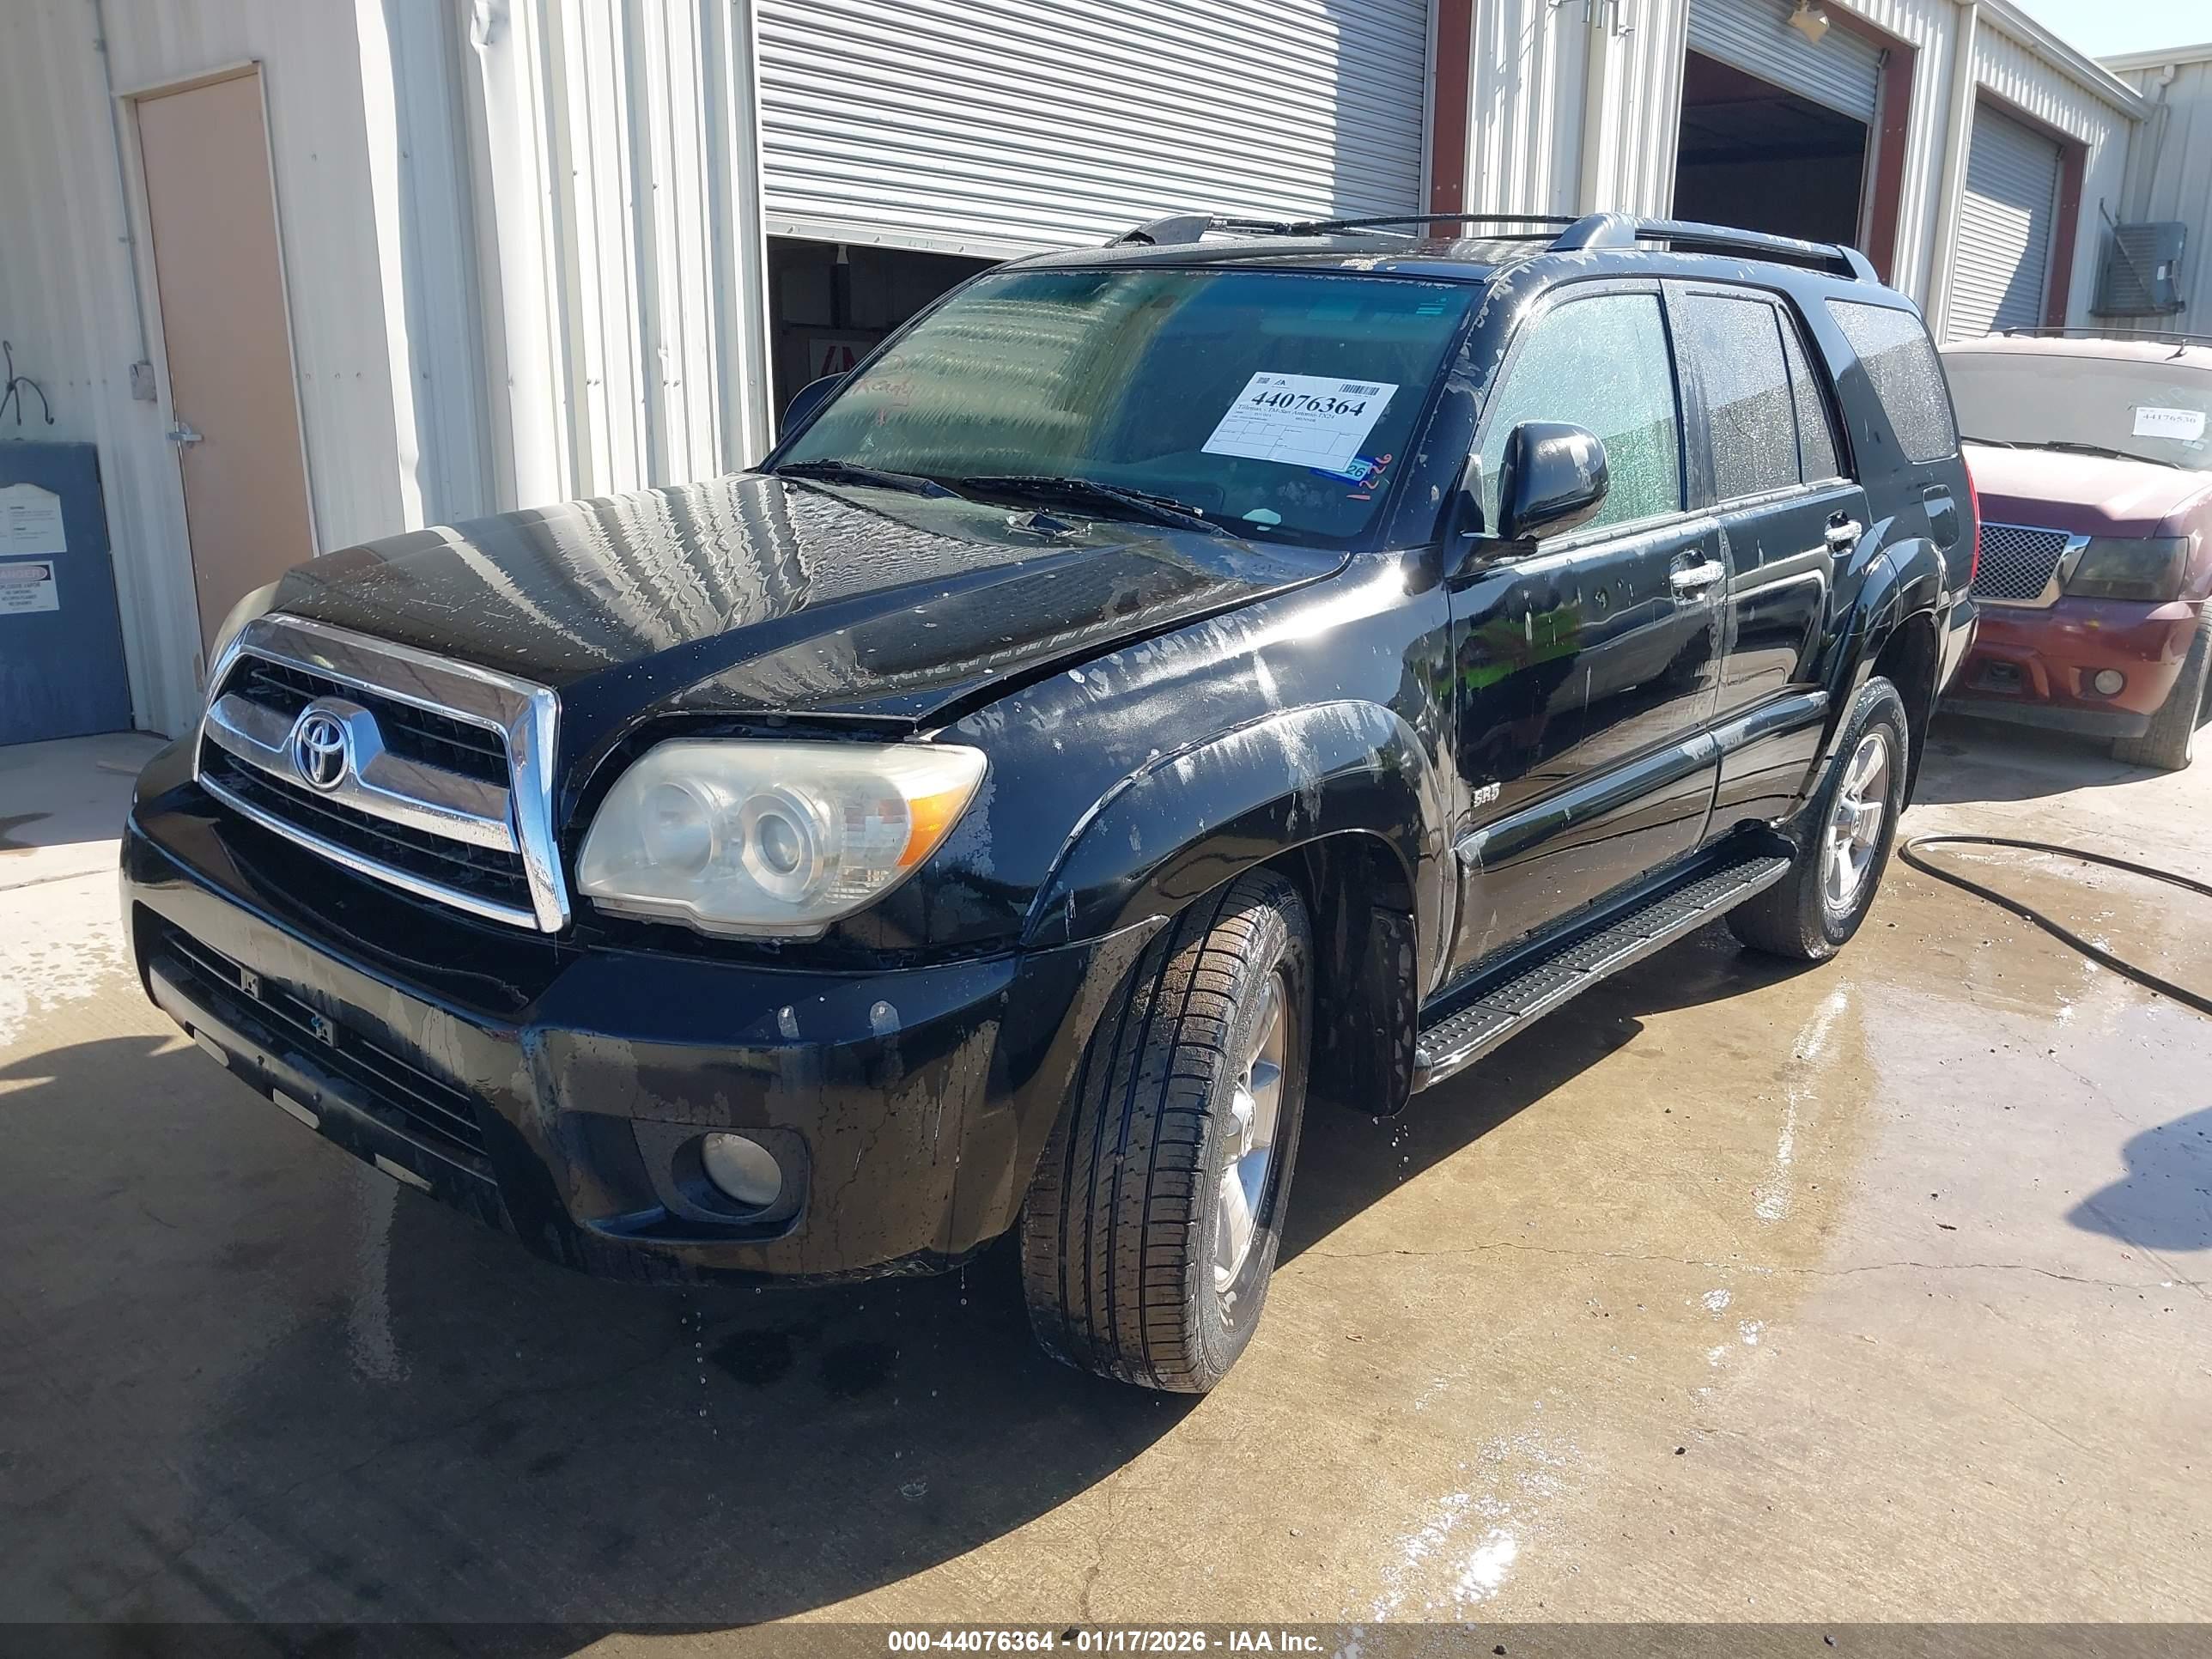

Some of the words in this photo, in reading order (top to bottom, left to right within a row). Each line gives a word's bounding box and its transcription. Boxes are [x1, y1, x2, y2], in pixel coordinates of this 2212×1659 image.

[1251, 392, 1367, 417] 44076364
[1348, 465, 1365, 477] 26
[1473, 782, 1501, 808] SR5
